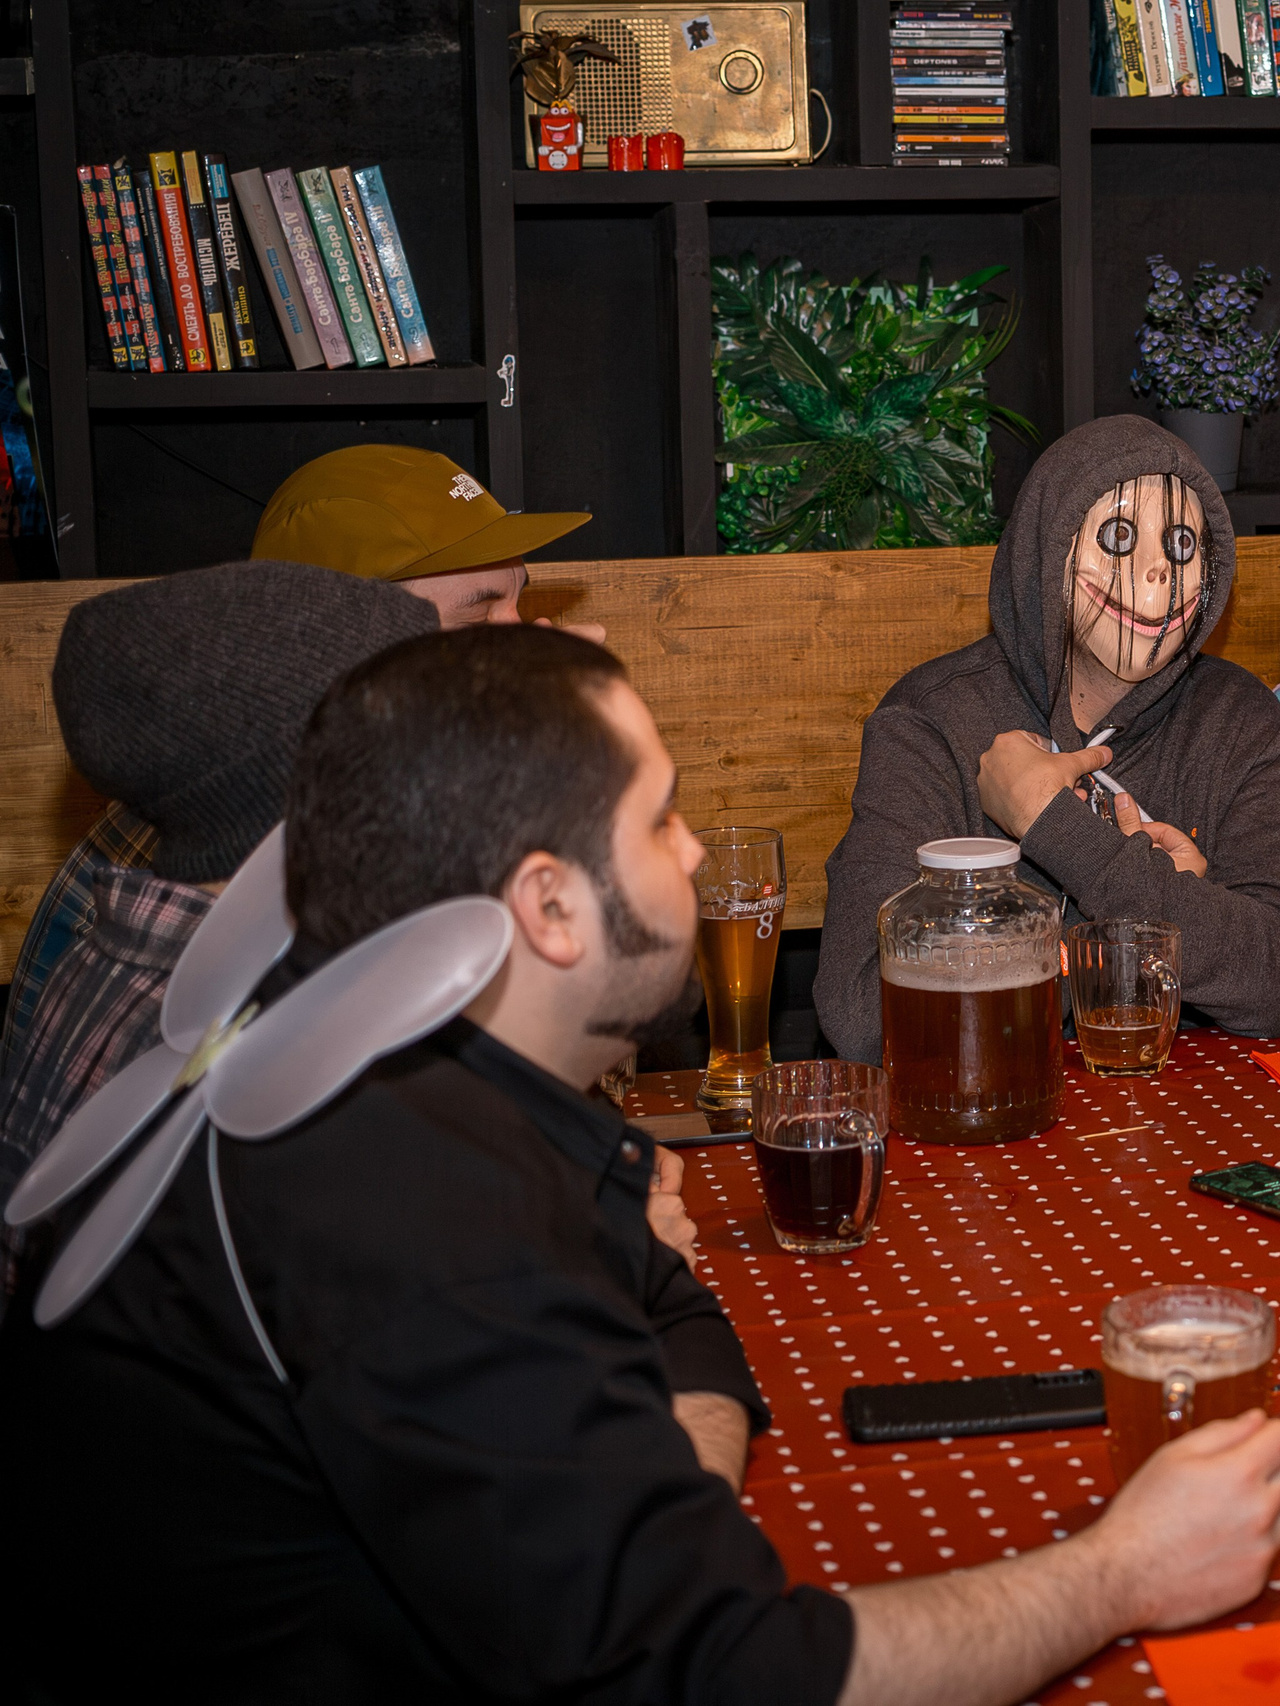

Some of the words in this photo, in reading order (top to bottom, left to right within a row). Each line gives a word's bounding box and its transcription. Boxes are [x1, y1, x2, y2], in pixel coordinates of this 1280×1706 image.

[339, 183, 350, 201] ТРИ
[165, 192, 187, 278] ВОСТРЕБОВАНИЯ
[284, 209, 297, 224] IV
[217, 202, 239, 271] ЖЕРЕБЕЦ
[116, 251, 128, 279] ТАЙНА
[198, 237, 216, 287] МСТИТЕЛЬ
[295, 224, 331, 326] Санта-Барбара
[325, 224, 362, 324] Санта-Барбара
[179, 283, 192, 299] ДО
[182, 302, 199, 341] СМЕРТЬ
[756, 911, 773, 939] 8
